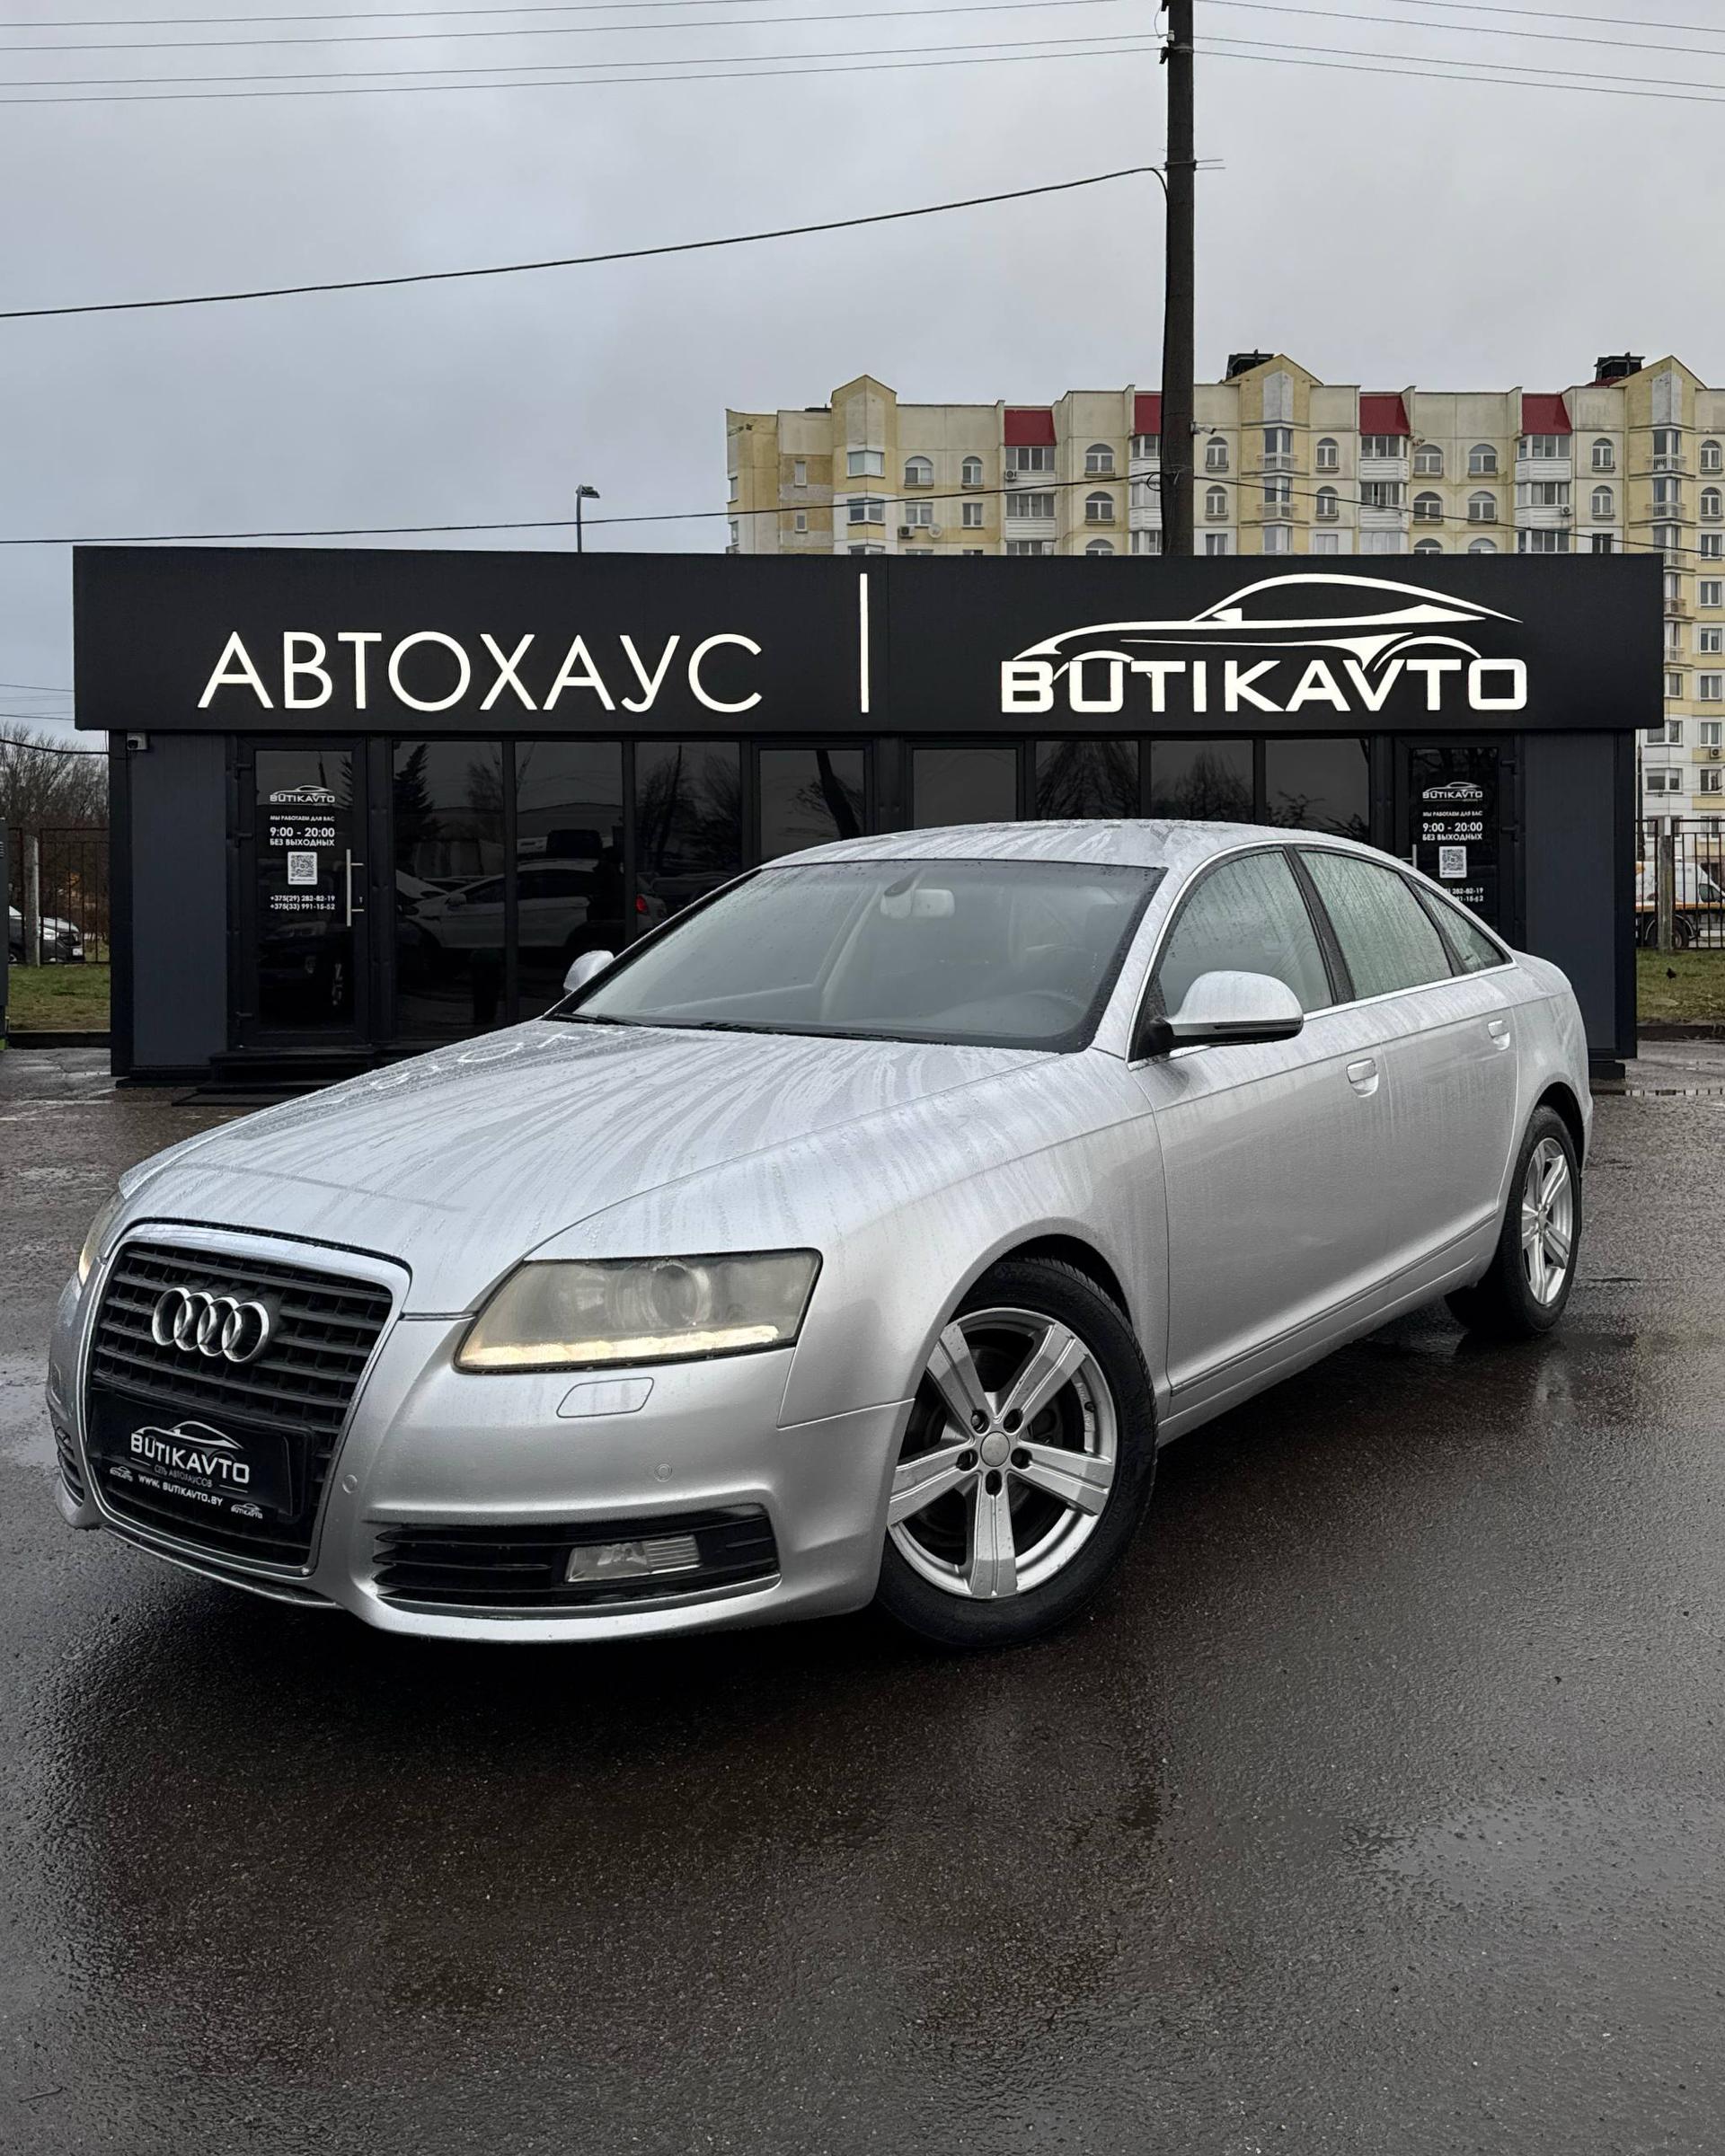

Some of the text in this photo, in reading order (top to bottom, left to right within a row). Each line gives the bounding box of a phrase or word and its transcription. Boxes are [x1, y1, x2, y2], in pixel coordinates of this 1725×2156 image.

[197, 631, 763, 713] АВТОХАУС
[1000, 658, 1528, 712] BUTIKAVTO
[270, 794, 335, 802] BUTIKAVTO
[1422, 791, 1482, 799] BUTIKAVTO
[270, 826, 294, 837] 9:00
[305, 826, 335, 837] 20:00
[1422, 822, 1445, 832] 9:00
[1455, 821, 1483, 832] 20:00
[270, 838, 335, 846] БЕЗ ВЫХОДНЫХ
[1438, 833, 1482, 841] ВЫХОДНЫХ
[130, 1433, 250, 1484] BUTIKAVTO
[163, 1481, 223, 1507] BUTIKAVTO.BY
